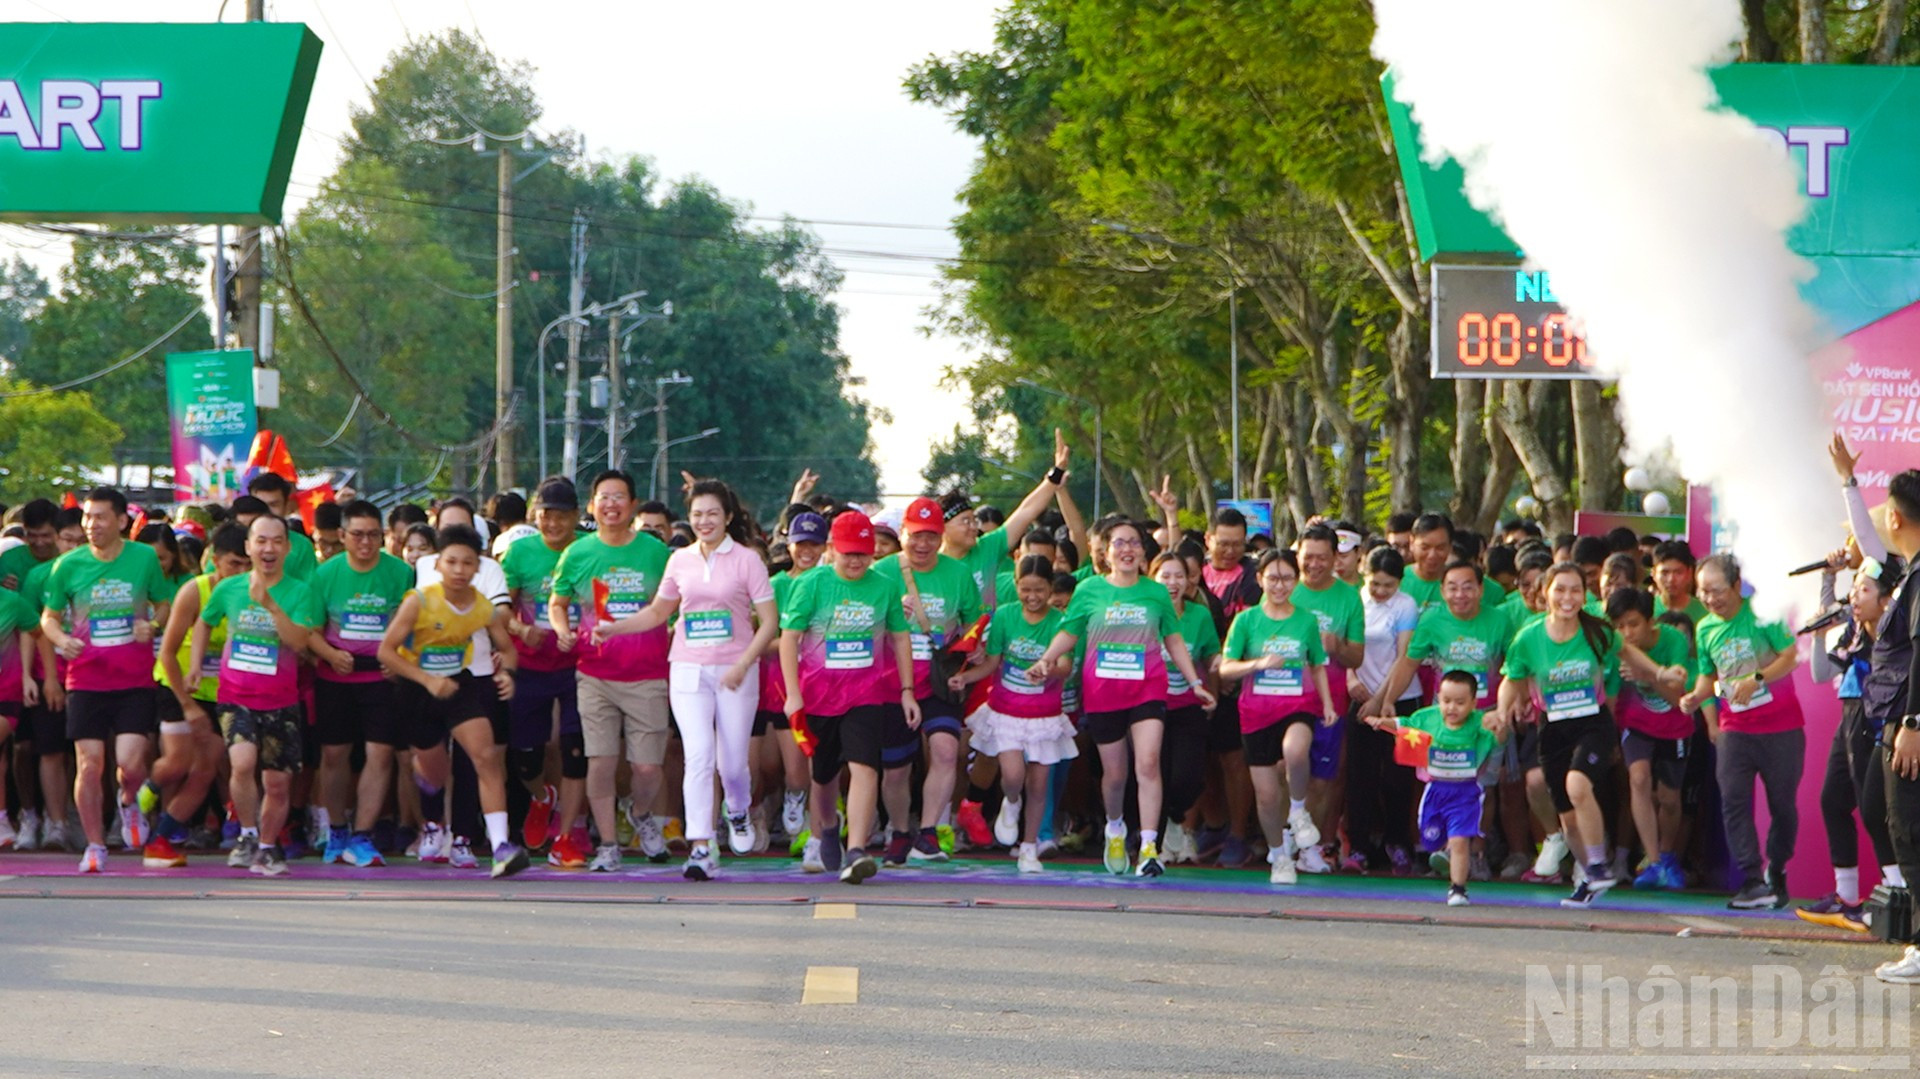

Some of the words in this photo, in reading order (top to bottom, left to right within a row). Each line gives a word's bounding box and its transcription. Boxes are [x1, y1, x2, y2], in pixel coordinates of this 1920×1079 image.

[1865, 366, 1911, 380] VPBank
[1859, 381, 1894, 398] SEN
[1833, 398, 1920, 425] MUSI
